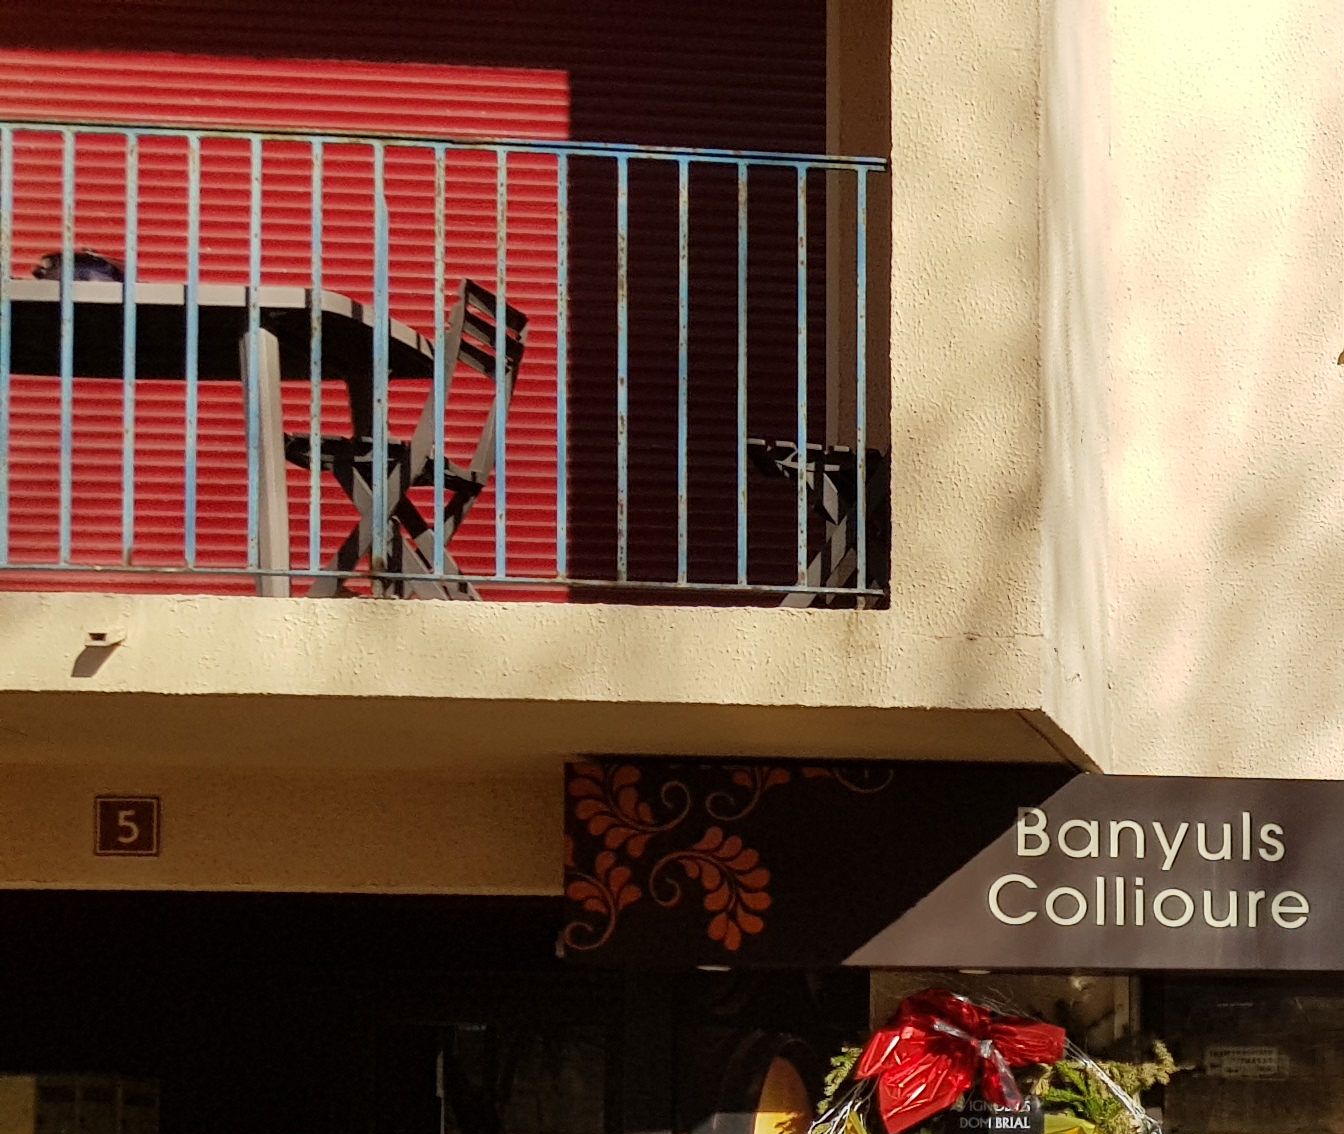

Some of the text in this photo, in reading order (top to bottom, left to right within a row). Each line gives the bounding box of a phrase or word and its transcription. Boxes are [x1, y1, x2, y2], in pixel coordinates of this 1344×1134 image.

[117, 810, 139, 843] 5
[1017, 807, 1286, 871] Banyuls
[988, 873, 1310, 929] Collioure
[995, 1116, 1031, 1129] BRIAL
